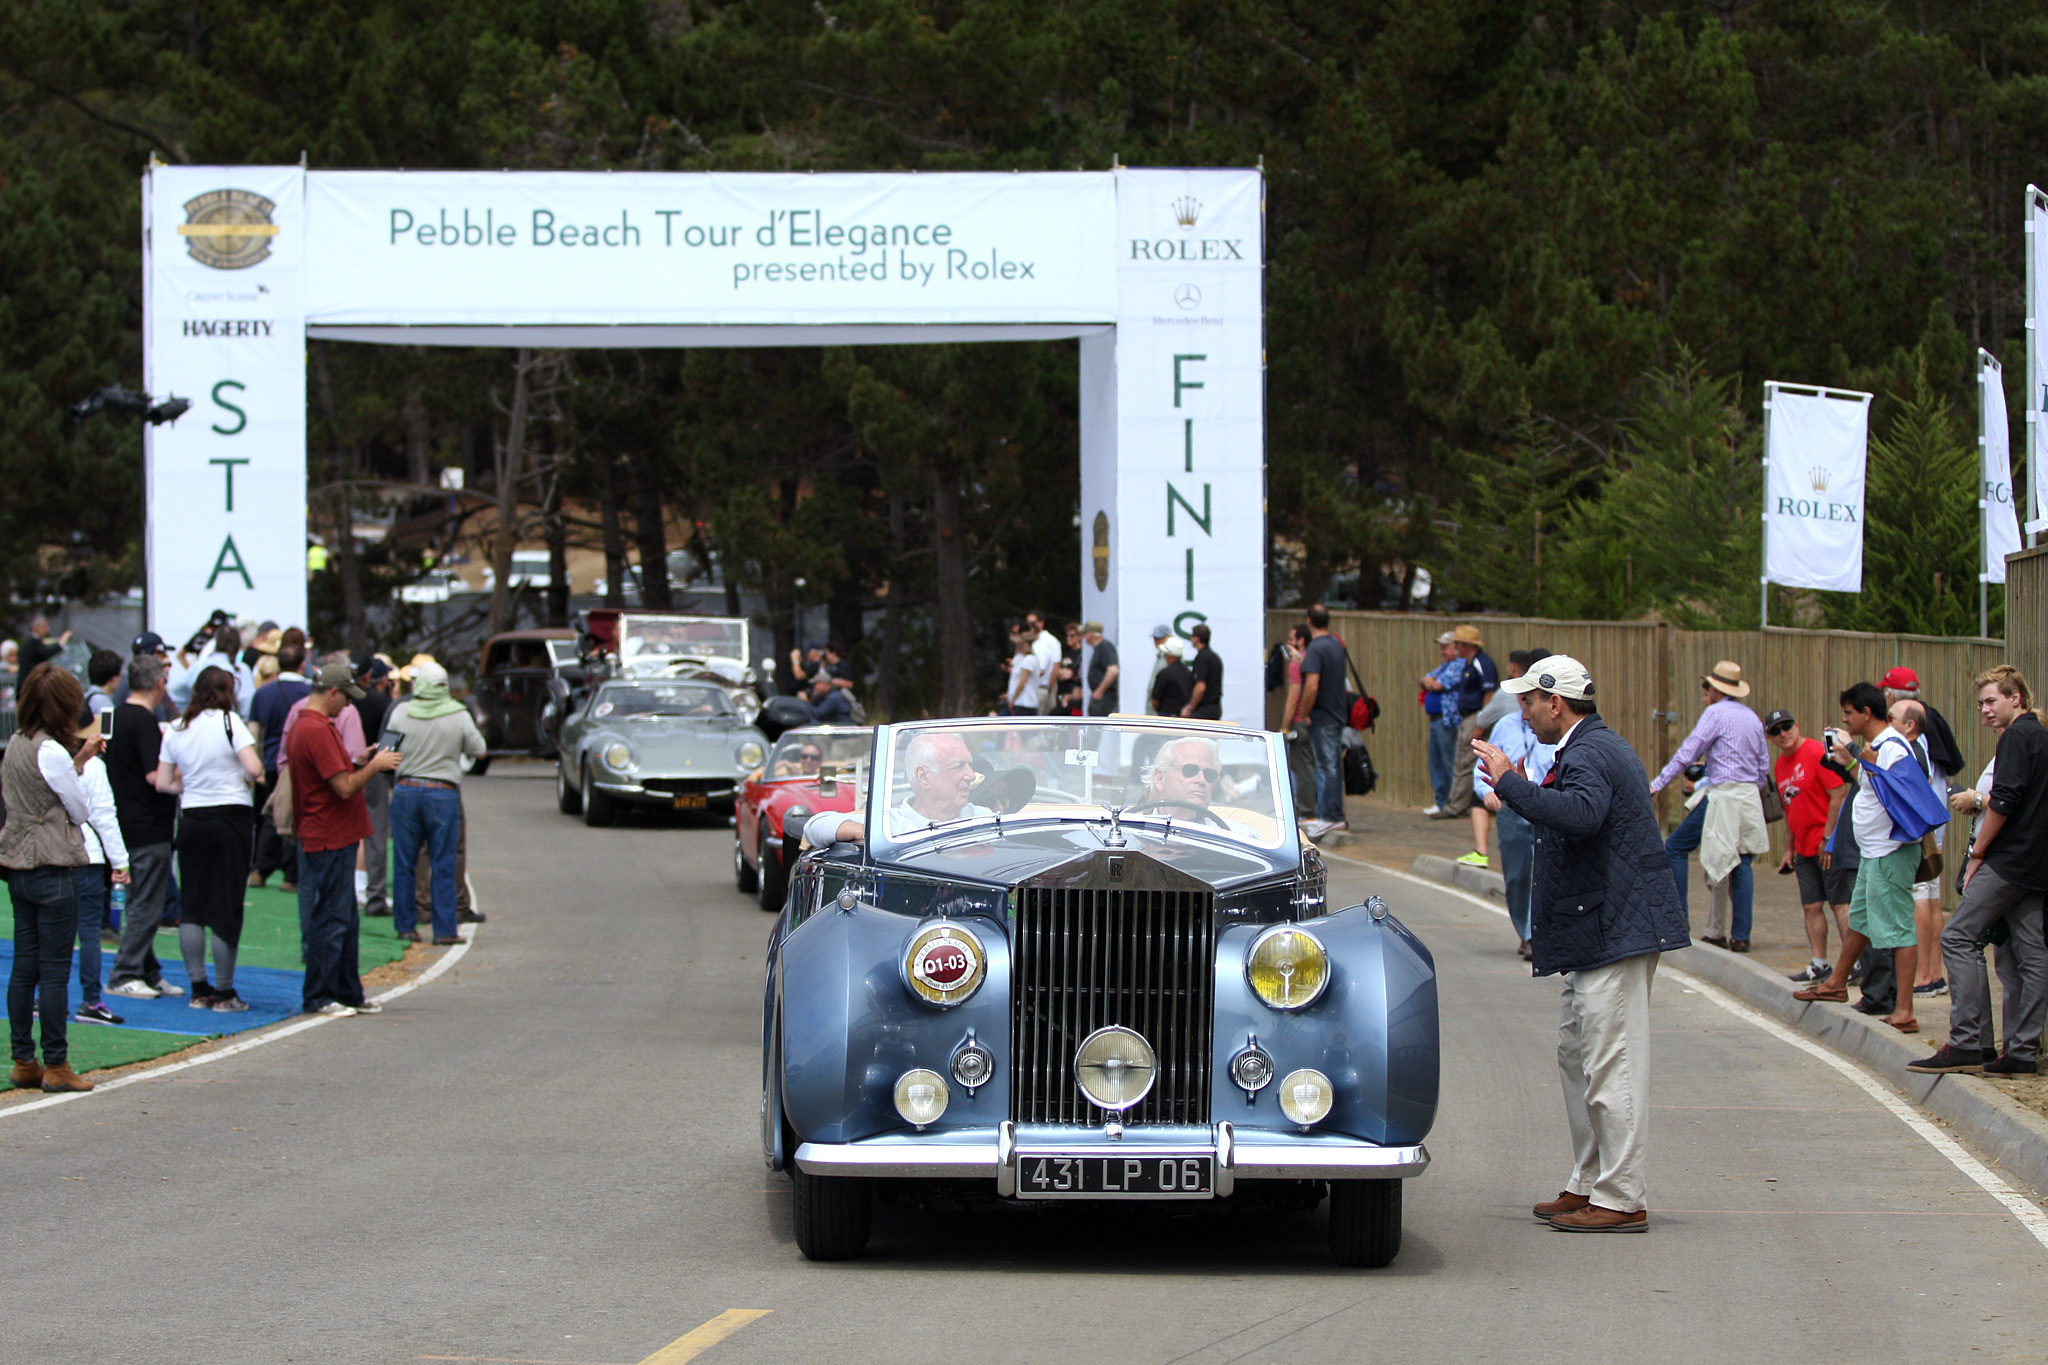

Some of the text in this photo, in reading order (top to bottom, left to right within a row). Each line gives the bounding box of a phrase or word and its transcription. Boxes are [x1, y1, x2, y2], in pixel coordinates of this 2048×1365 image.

[389, 207, 953, 256] Pebble Beach Tour d'Elegance
[1130, 238, 1245, 261] ROLEX
[733, 248, 1035, 290] presented by Rolex
[183, 319, 274, 337] HAGERTY
[204, 379, 256, 620] STA
[1776, 496, 1858, 523] ROLEX
[1031, 1158, 1201, 1191] 431 LP 06
